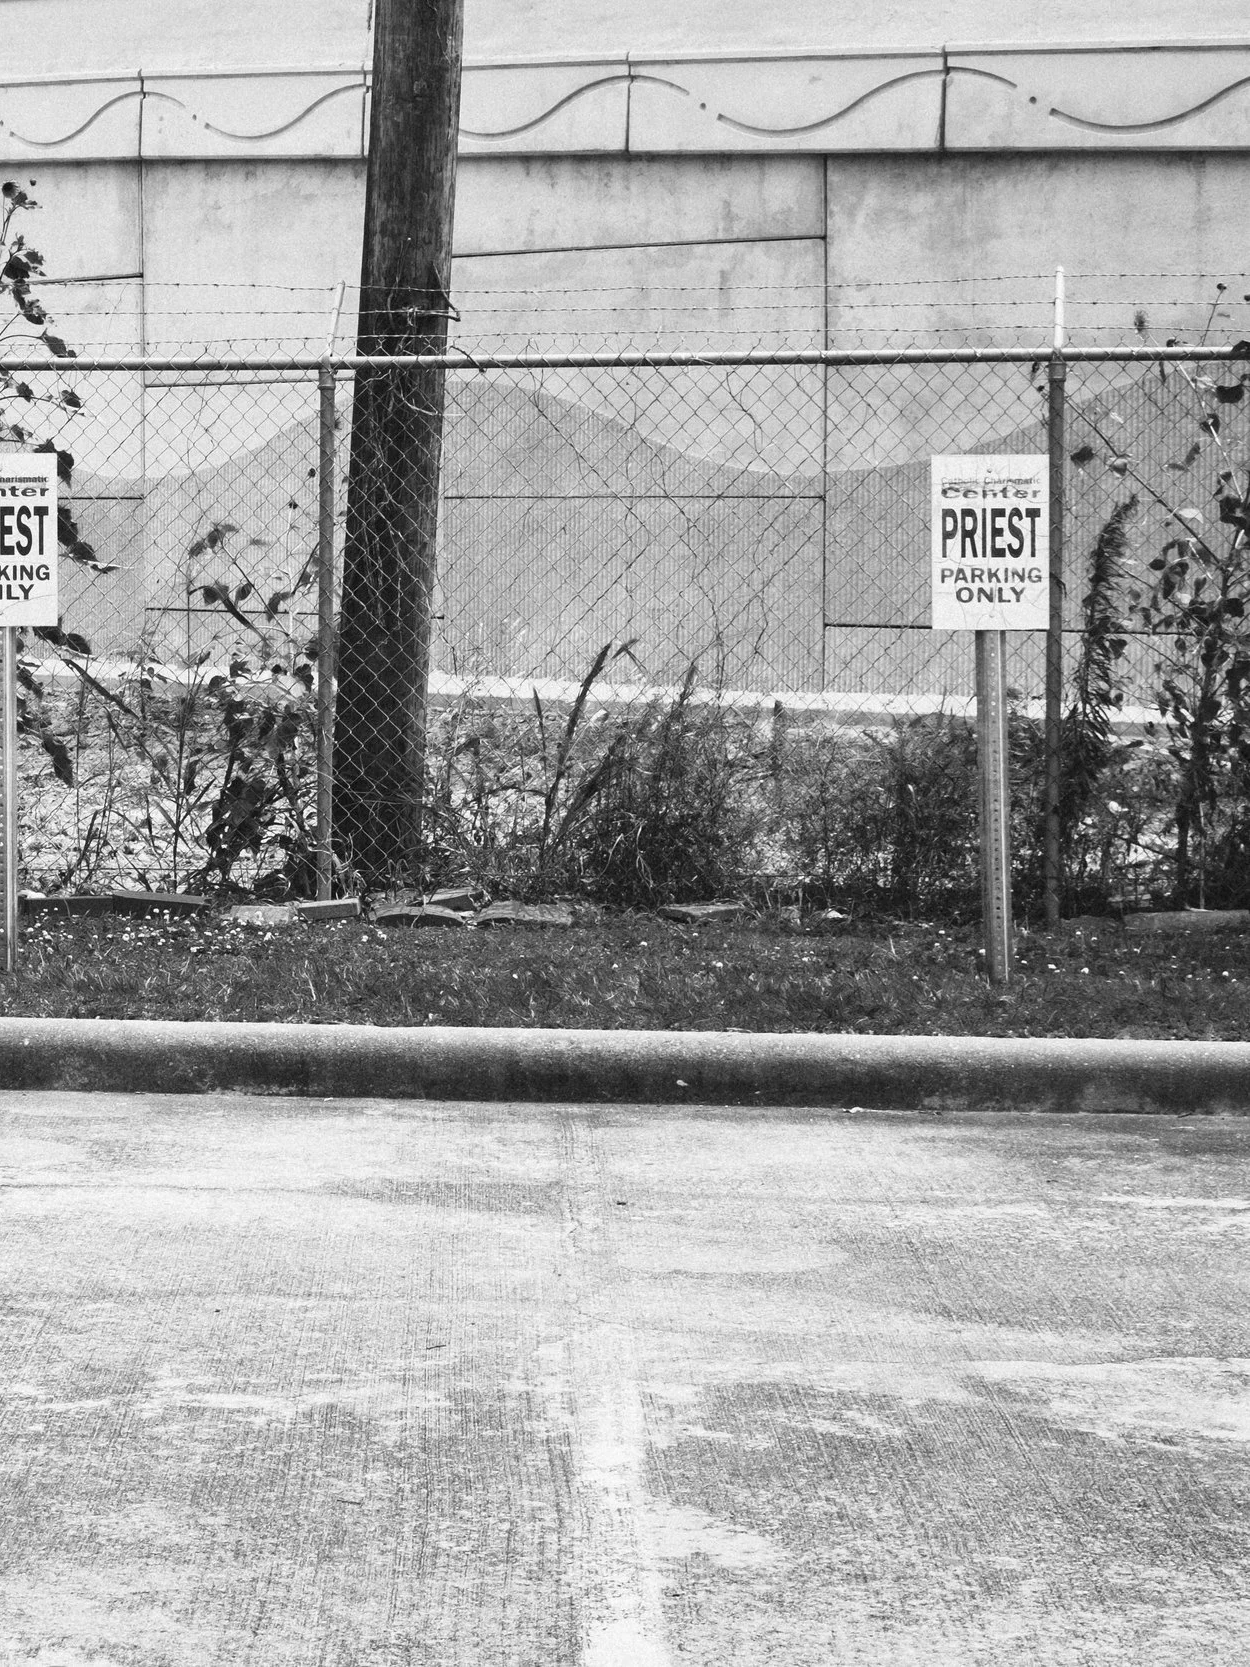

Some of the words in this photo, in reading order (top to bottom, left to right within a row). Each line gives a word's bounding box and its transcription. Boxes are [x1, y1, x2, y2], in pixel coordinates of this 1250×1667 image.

[941, 486, 1041, 499] Center
[941, 507, 1041, 558] PRIEST
[941, 567, 1042, 583] PARKING
[955, 587, 1026, 603] ONLY
